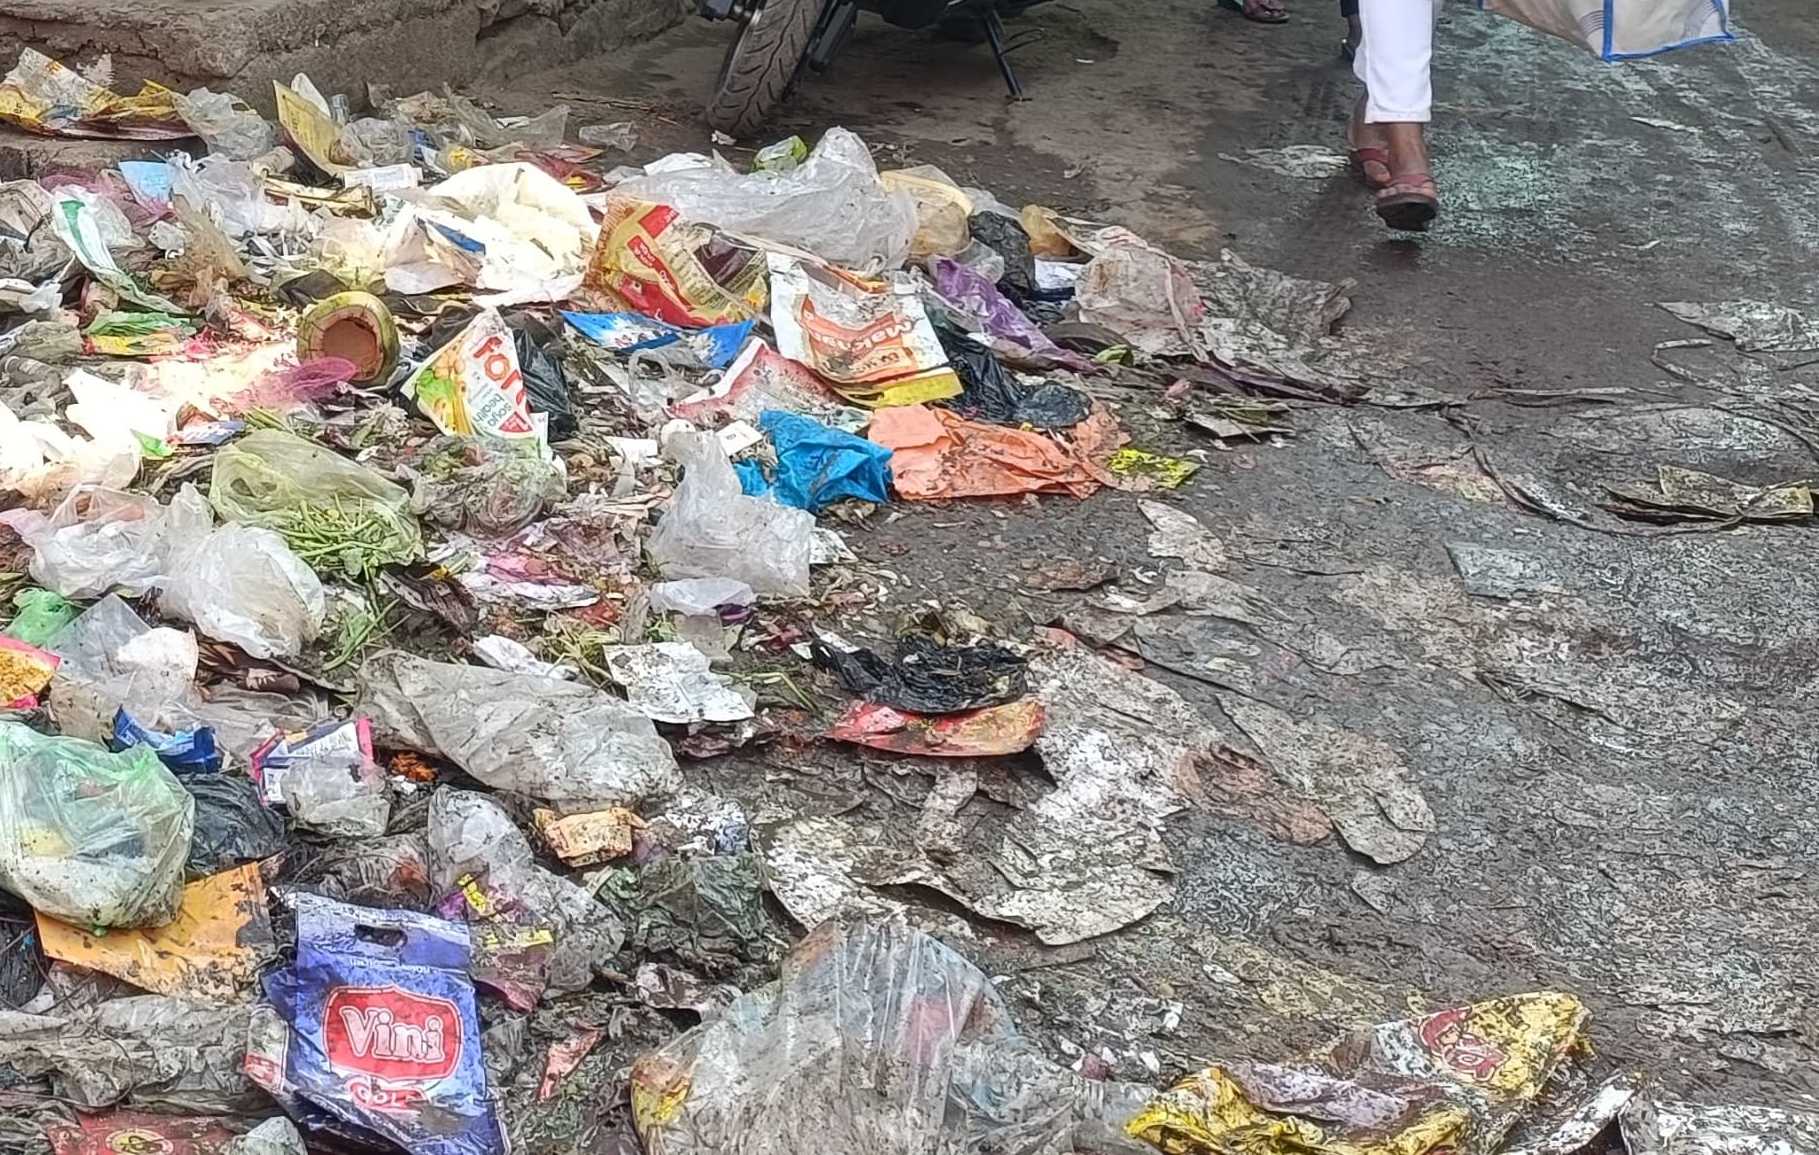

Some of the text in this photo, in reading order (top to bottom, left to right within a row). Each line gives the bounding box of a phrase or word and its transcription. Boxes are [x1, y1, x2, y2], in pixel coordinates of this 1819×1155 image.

[472, 393, 505, 423] health
[487, 402, 512, 427] soya
[340, 1005, 445, 1064] Vini
